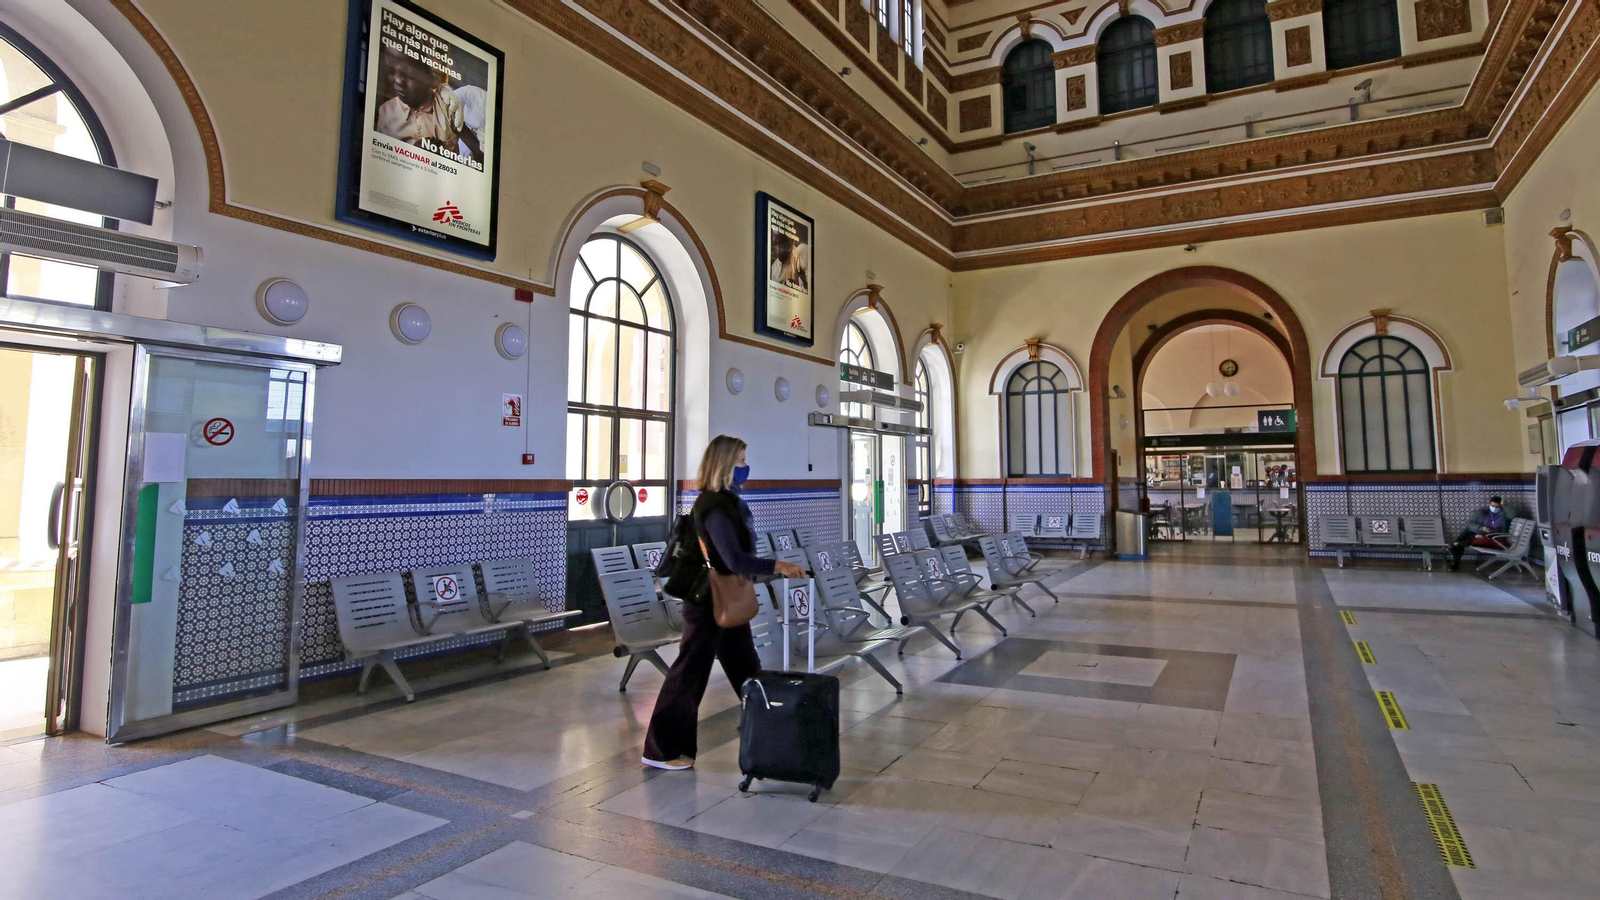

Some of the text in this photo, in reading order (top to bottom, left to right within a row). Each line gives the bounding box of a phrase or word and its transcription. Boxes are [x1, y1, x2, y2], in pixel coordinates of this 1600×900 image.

[382, 24, 453, 65] da más miedo
[383, 11, 448, 51] Hay algo que
[382, 36, 461, 80] que las vacunas
[372, 138, 457, 175] Envía VACUNAR al 28033
[421, 137, 483, 171] No tenerlas
